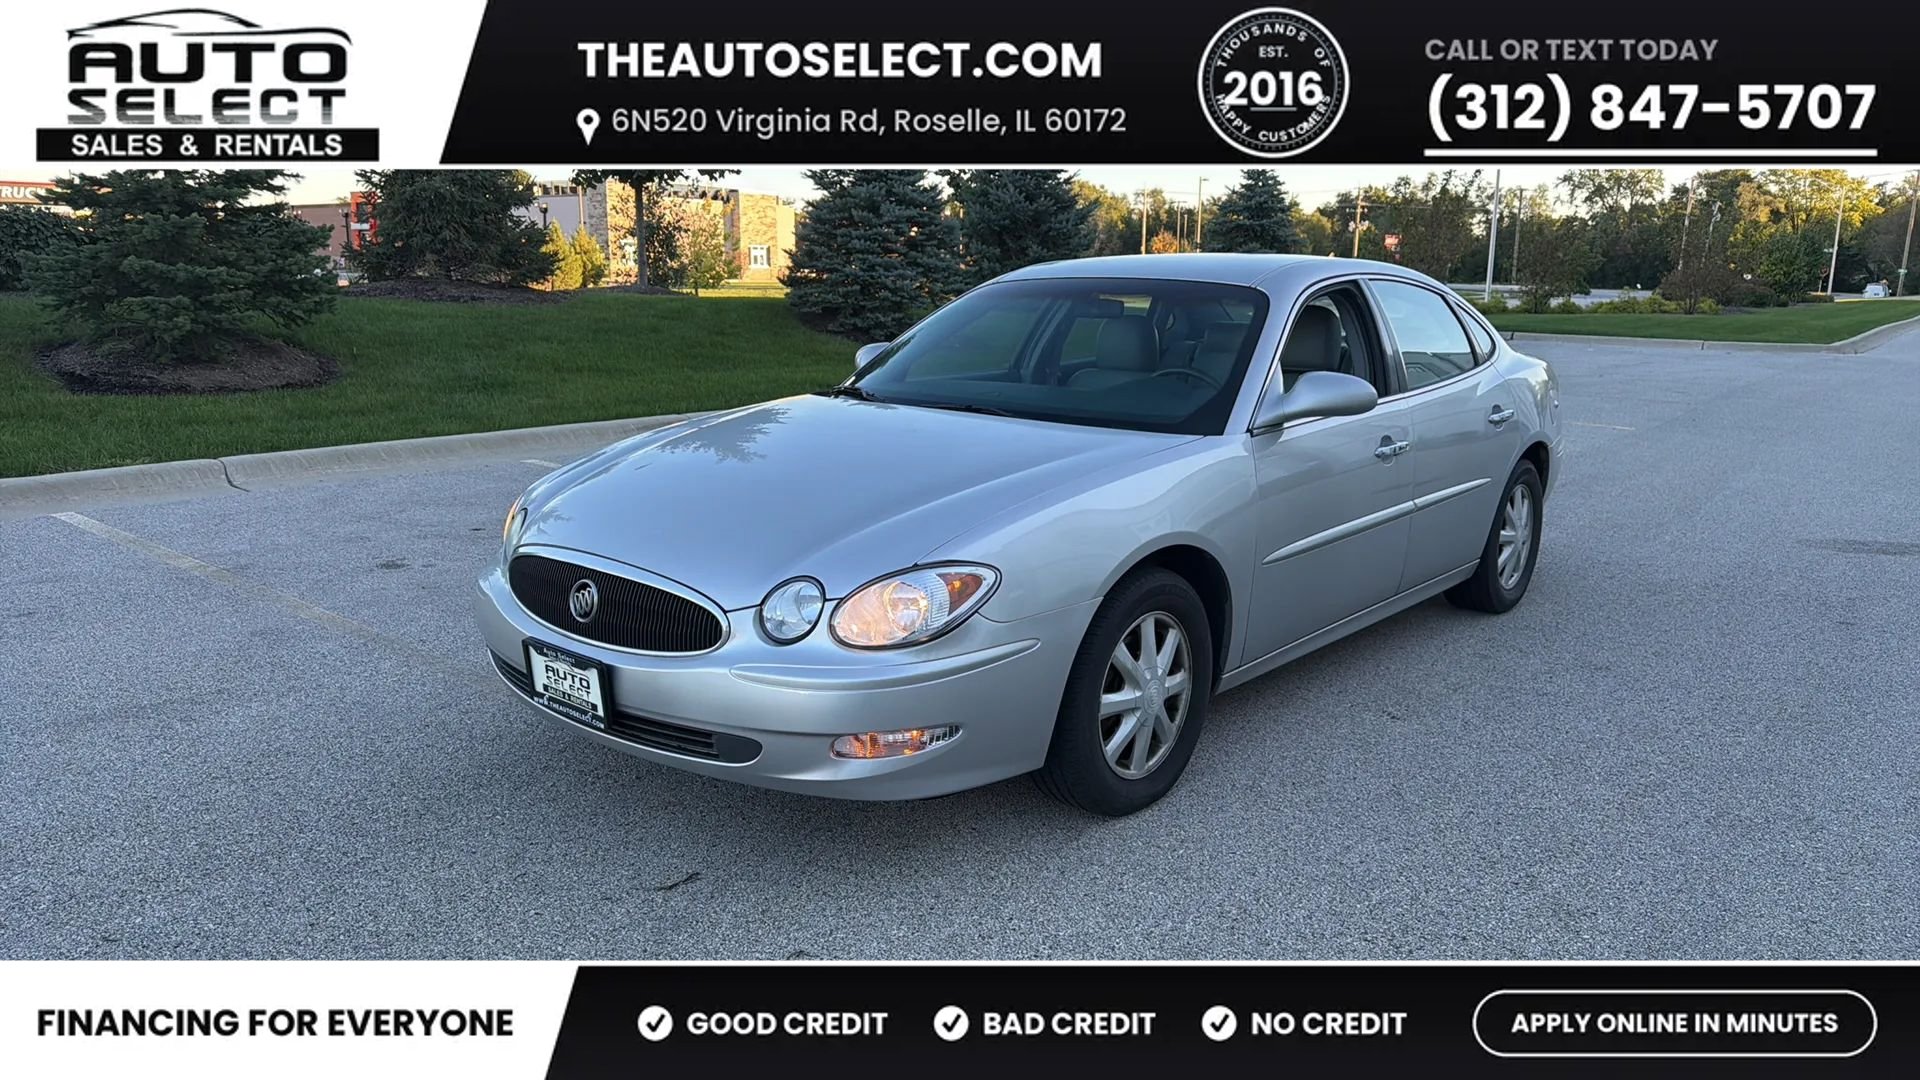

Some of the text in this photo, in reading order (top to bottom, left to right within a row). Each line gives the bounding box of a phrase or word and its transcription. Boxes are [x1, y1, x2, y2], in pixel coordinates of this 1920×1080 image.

[0, 186, 46, 199] RUC
[545, 664, 590, 690] AUTO
[546, 675, 591, 700] SELECT
[548, 687, 563, 698] SALES
[571, 695, 592, 709] RENTALS
